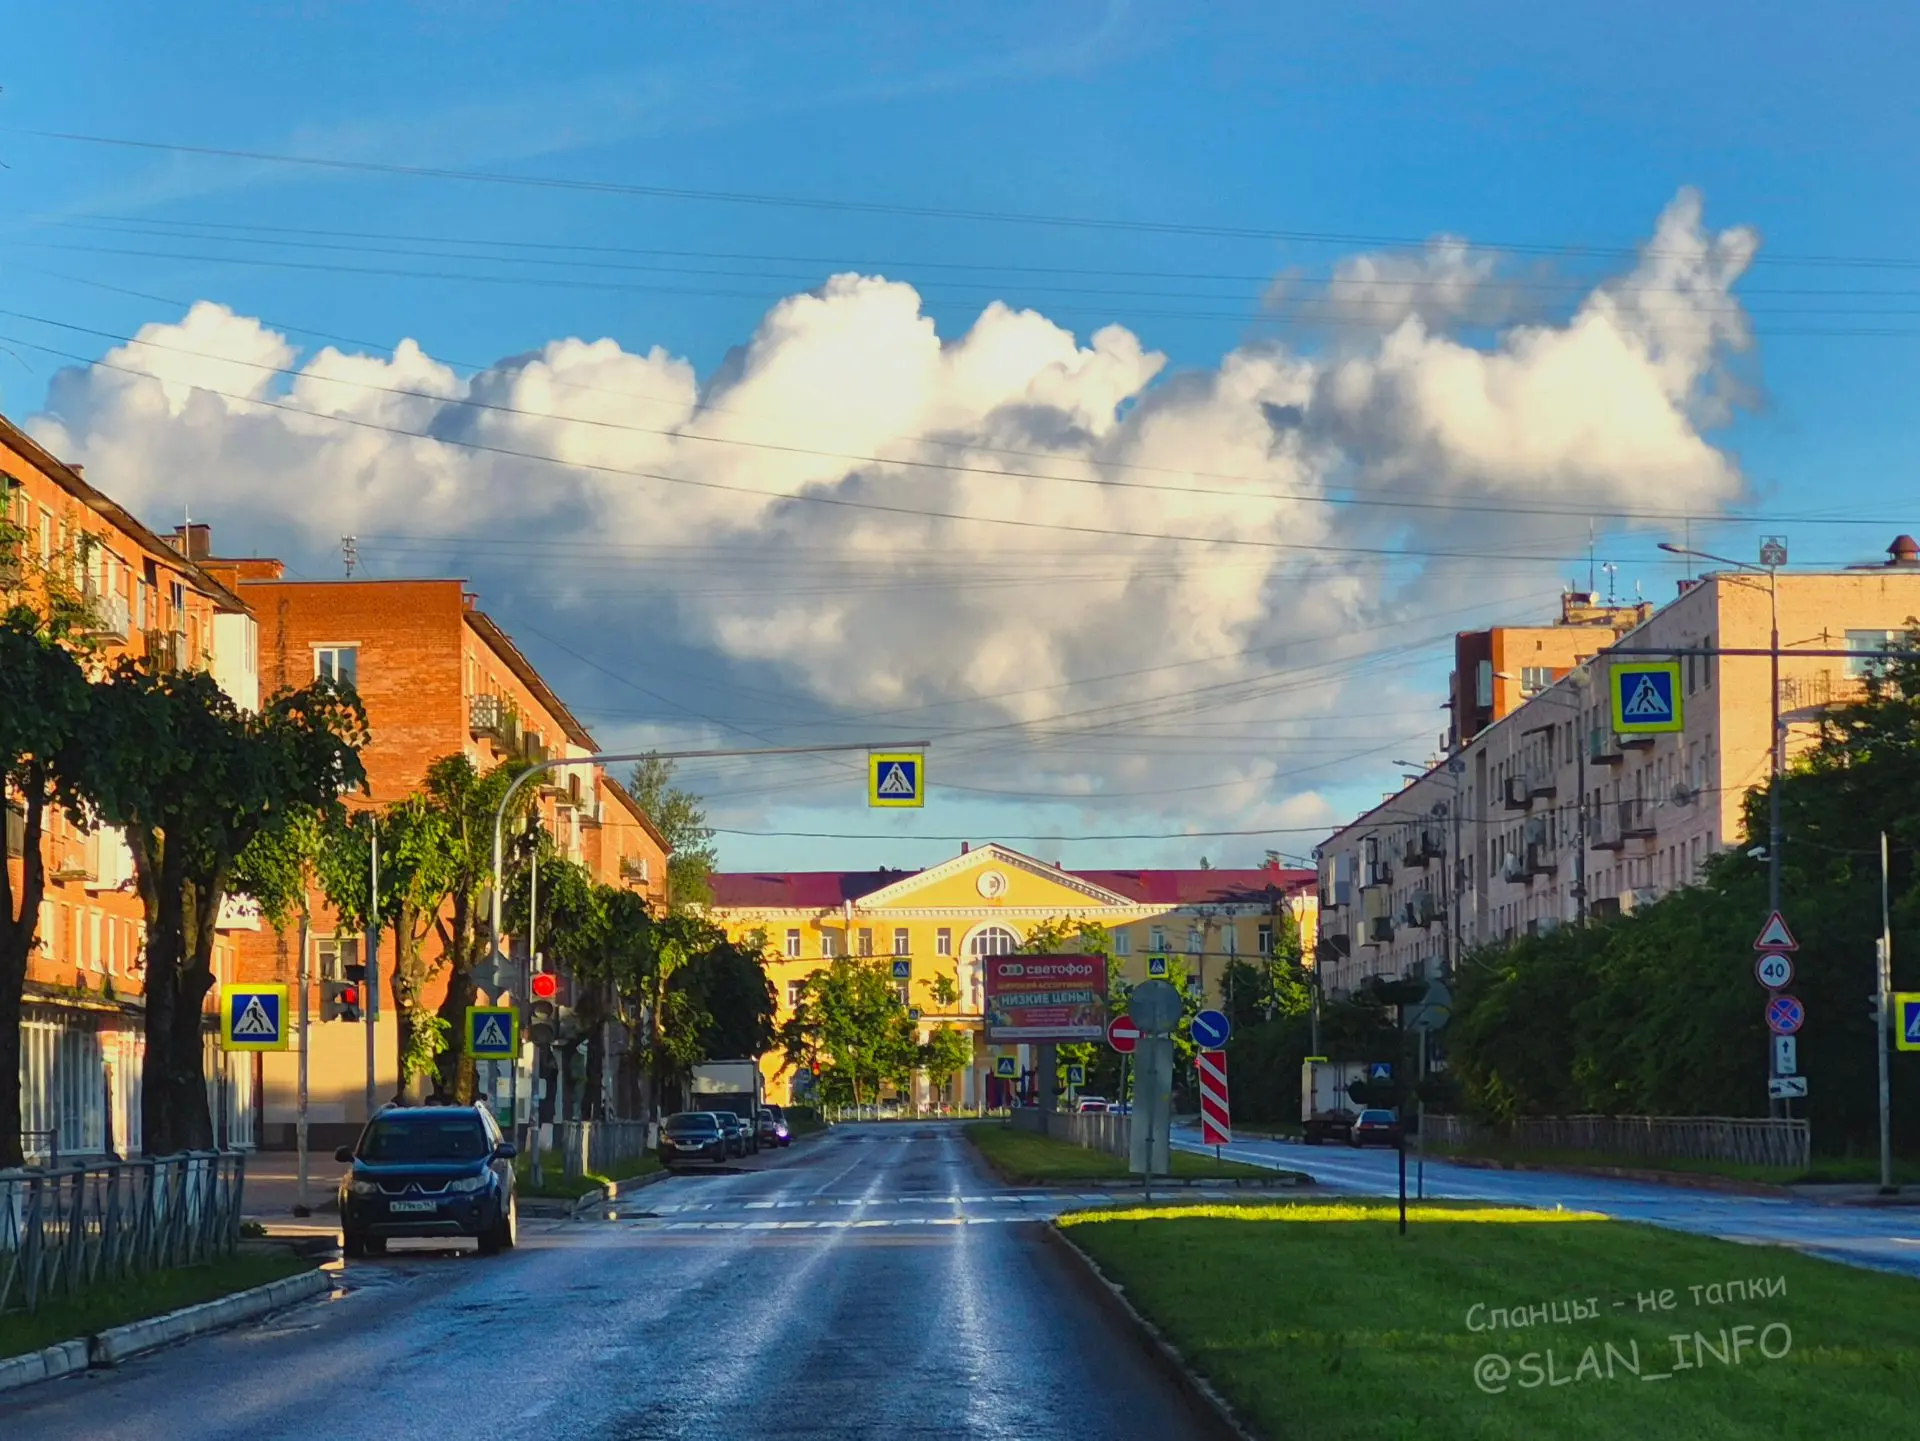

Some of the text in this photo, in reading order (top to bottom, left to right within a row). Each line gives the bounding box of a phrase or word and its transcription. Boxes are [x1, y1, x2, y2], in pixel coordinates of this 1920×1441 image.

[1026, 963, 1093, 976] светофор
[1764, 963, 1784, 978] 40
[1001, 991, 1091, 1006] НИЗКИЕ ЦЕНЫ!
